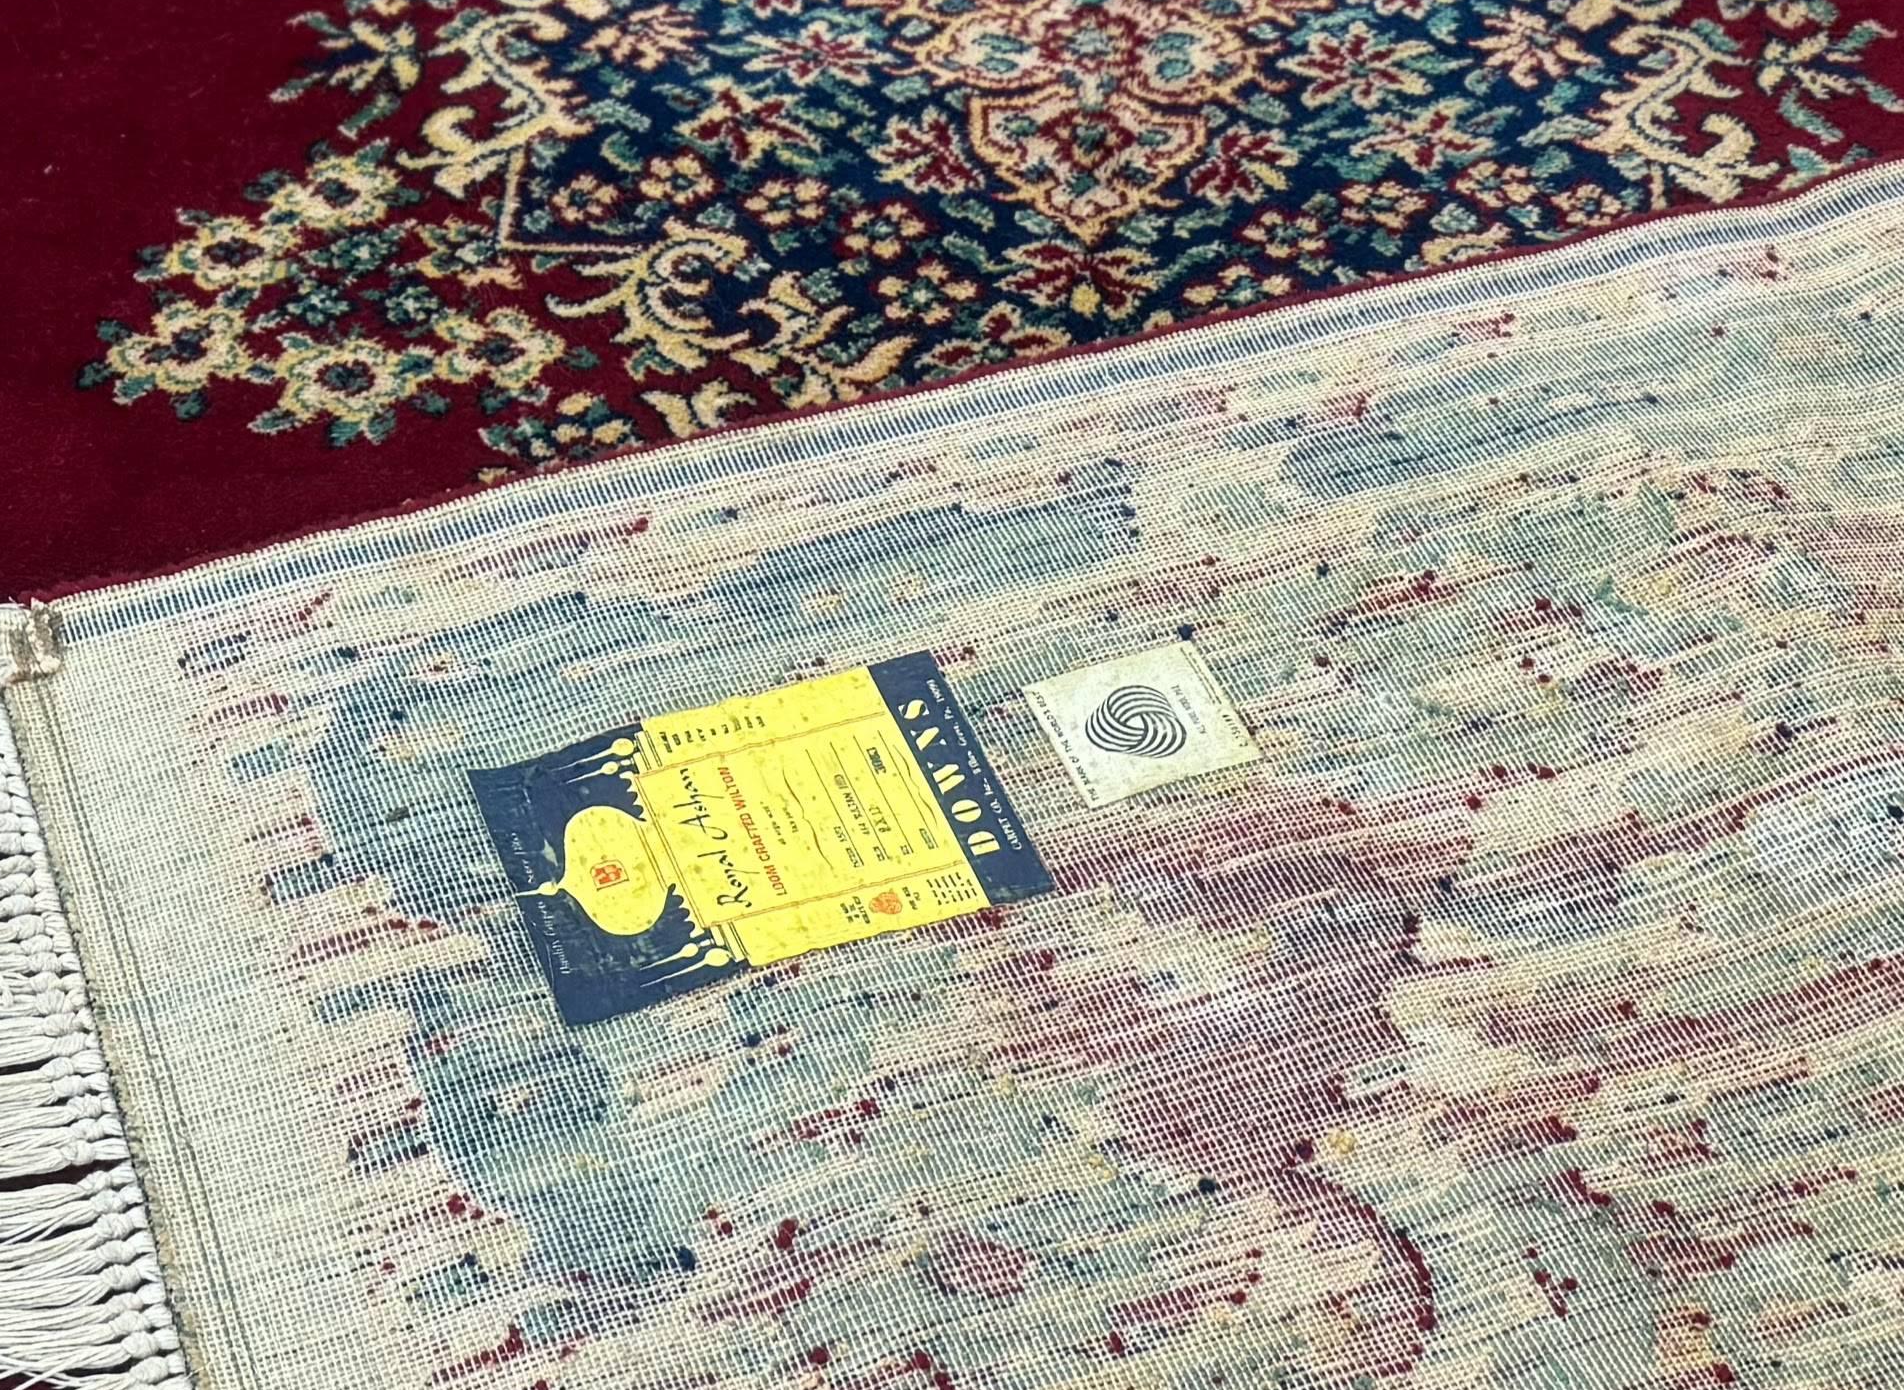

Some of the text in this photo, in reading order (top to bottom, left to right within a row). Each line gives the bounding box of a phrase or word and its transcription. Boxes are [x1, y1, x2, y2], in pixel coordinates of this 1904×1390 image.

[896, 696, 1002, 857] DOWNS
[696, 848, 760, 907] Royal
[716, 764, 787, 896] LOOM CRAFTED WILTON
[997, 815, 1023, 851] CARPET
